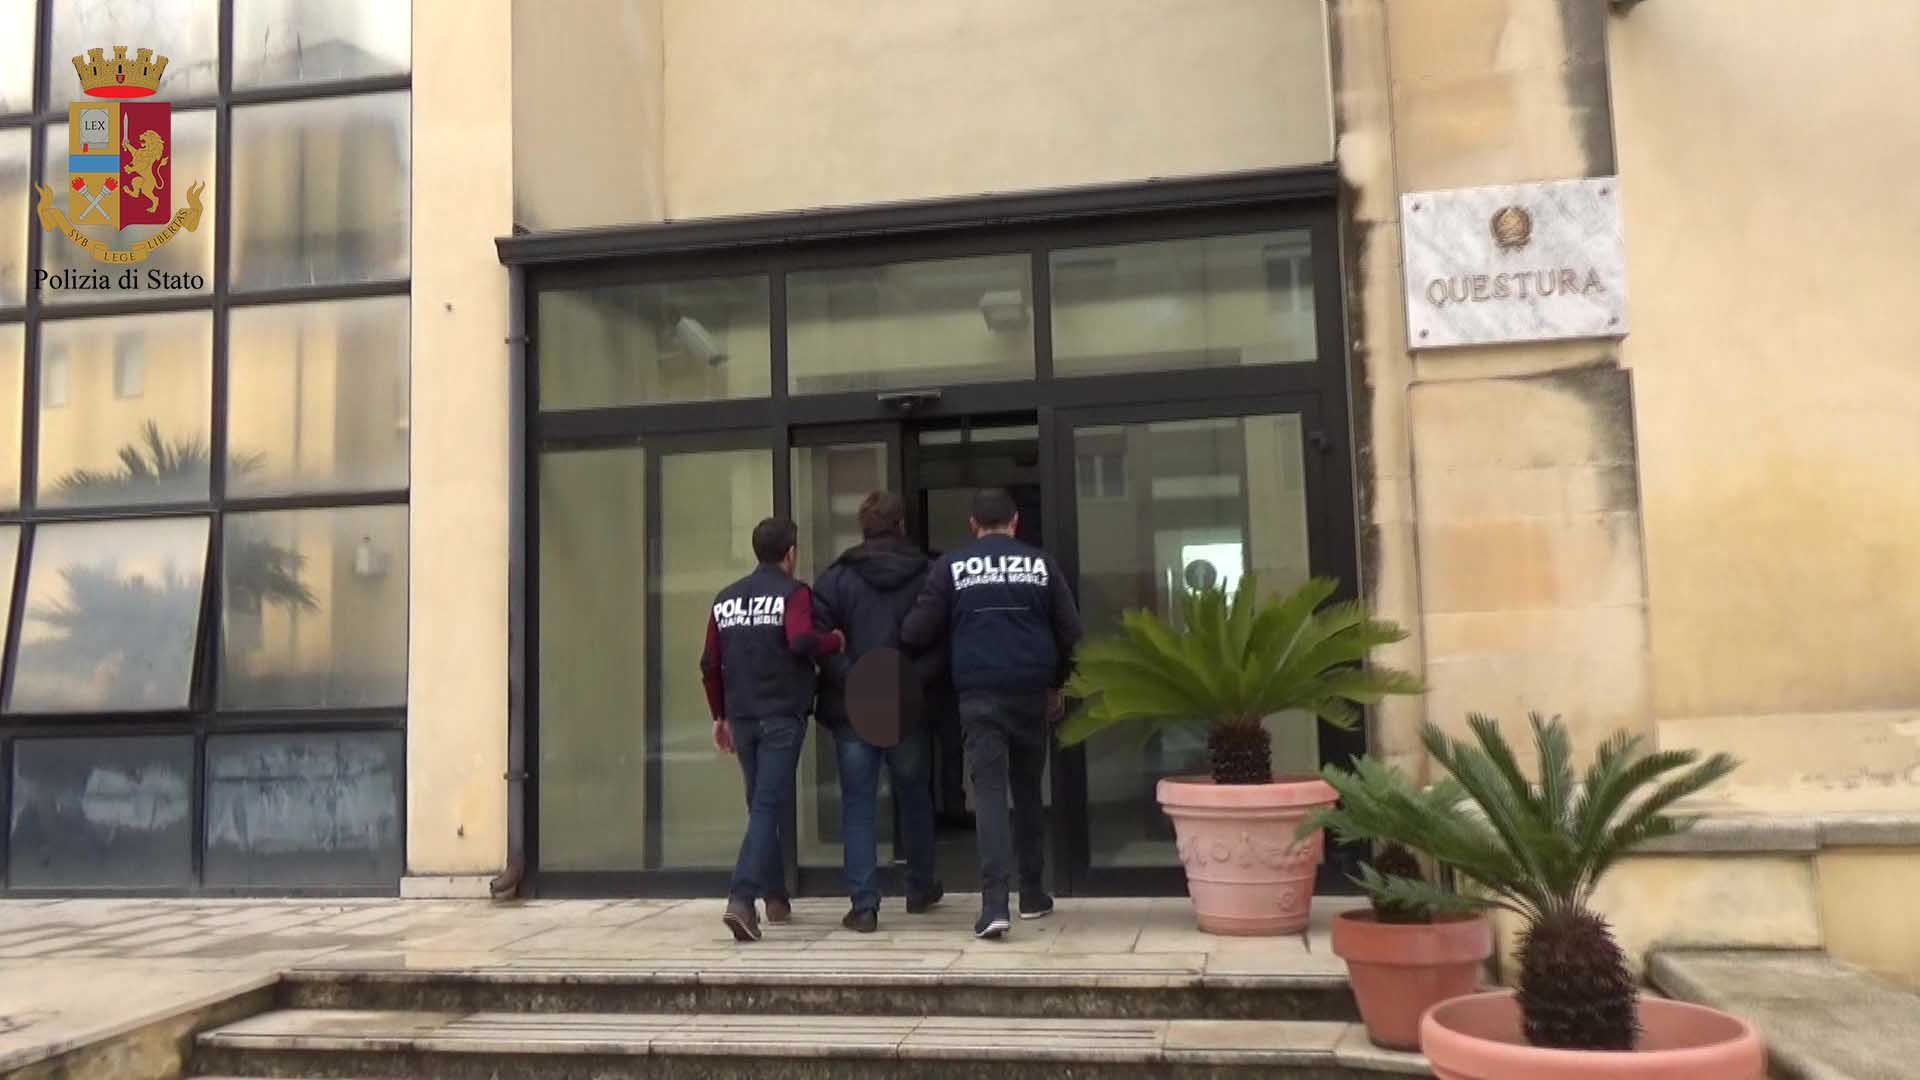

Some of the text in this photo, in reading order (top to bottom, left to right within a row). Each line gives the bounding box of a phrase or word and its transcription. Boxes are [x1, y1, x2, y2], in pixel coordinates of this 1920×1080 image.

[1426, 266, 1606, 308] QUESTURA
[950, 556, 1048, 580] POLIZIA
[713, 596, 784, 623] POLIZIA
